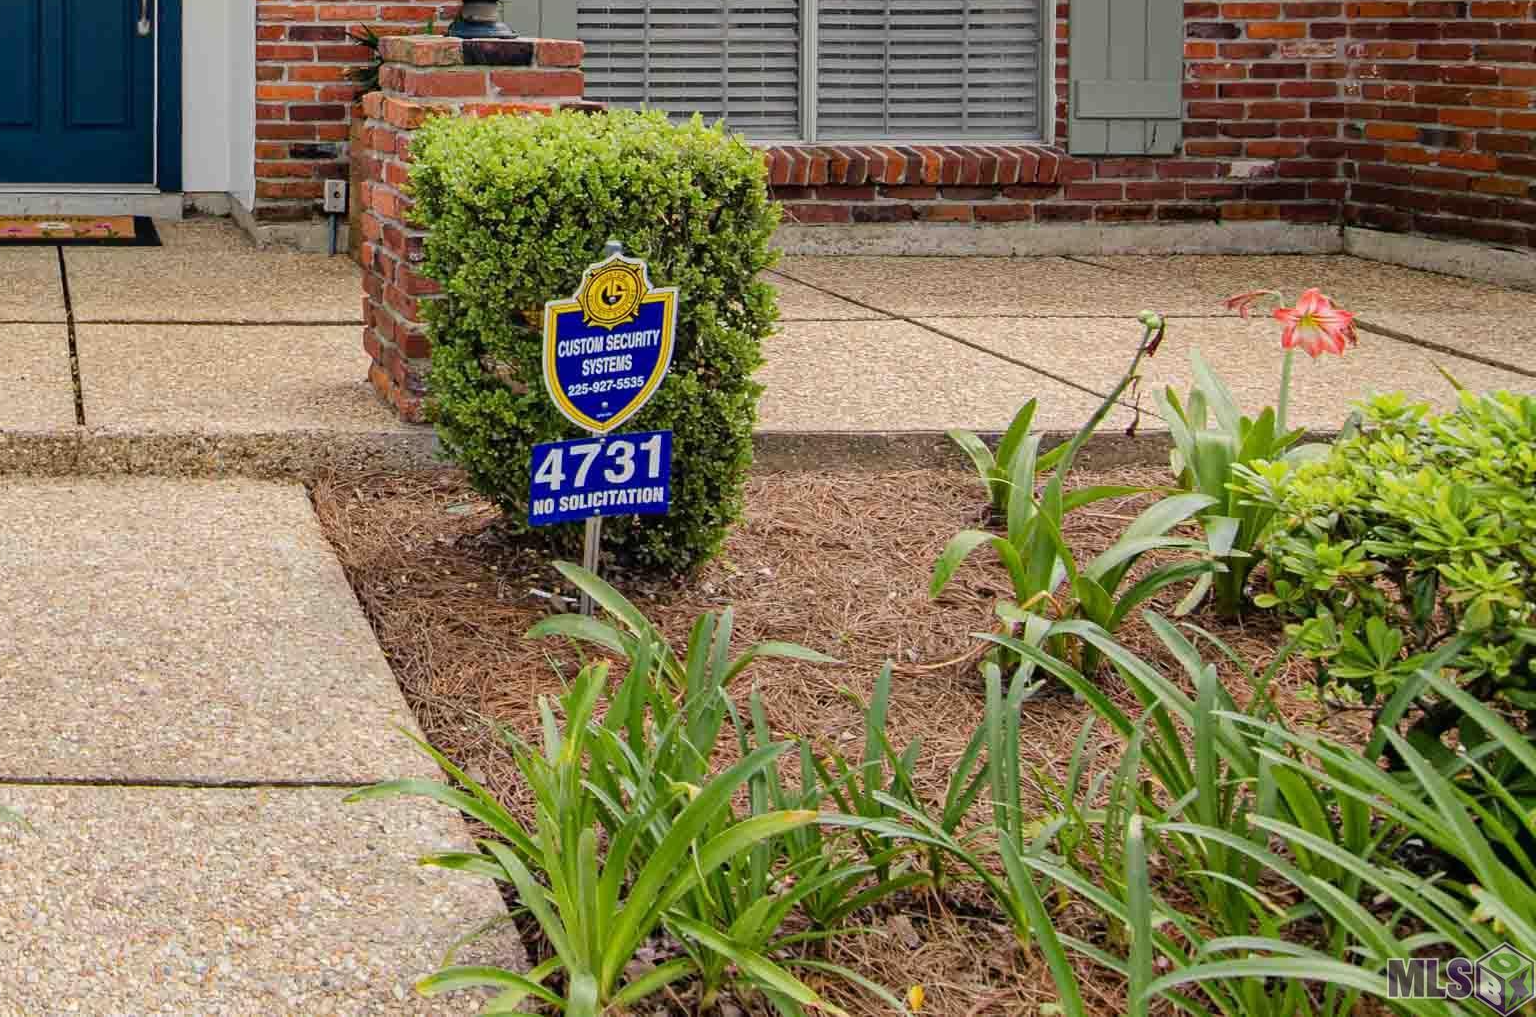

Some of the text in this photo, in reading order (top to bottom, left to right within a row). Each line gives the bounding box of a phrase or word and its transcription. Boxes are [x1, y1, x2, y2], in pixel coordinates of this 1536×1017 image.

[557, 329, 660, 358] CUSTOM SECURITY
[581, 354, 633, 376] SYSTEMS
[567, 375, 644, 396] 225-927-5535
[534, 434, 663, 491] 4731
[532, 486, 664, 516] NO SOLICITATION
